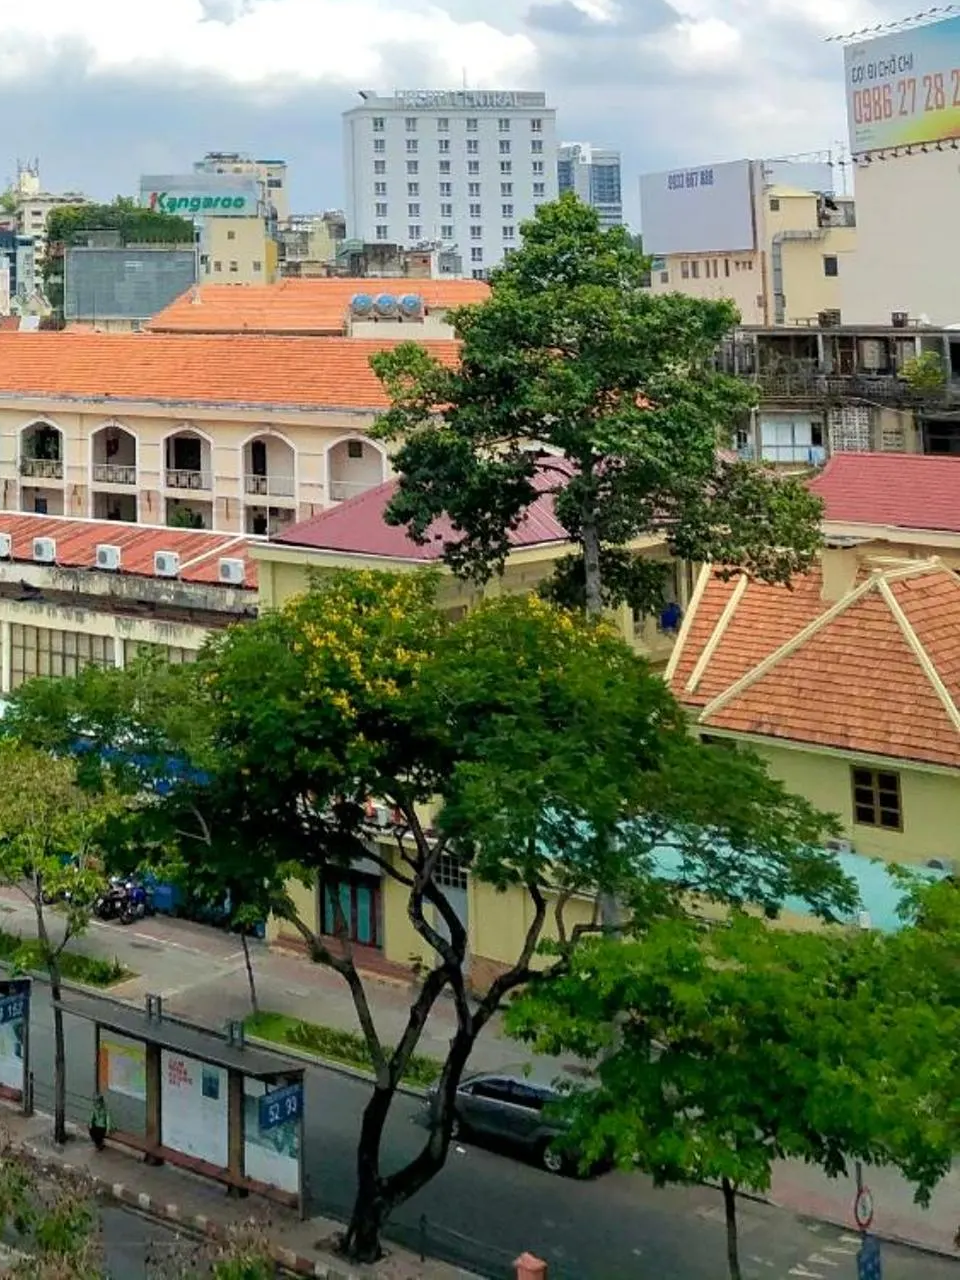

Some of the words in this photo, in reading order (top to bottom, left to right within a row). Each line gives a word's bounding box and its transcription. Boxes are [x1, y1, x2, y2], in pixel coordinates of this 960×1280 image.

[853, 83, 892, 124] 0986
[898, 77, 916, 116] 27
[923, 72, 945, 112] 28
[150, 192, 245, 212] Kangaroo
